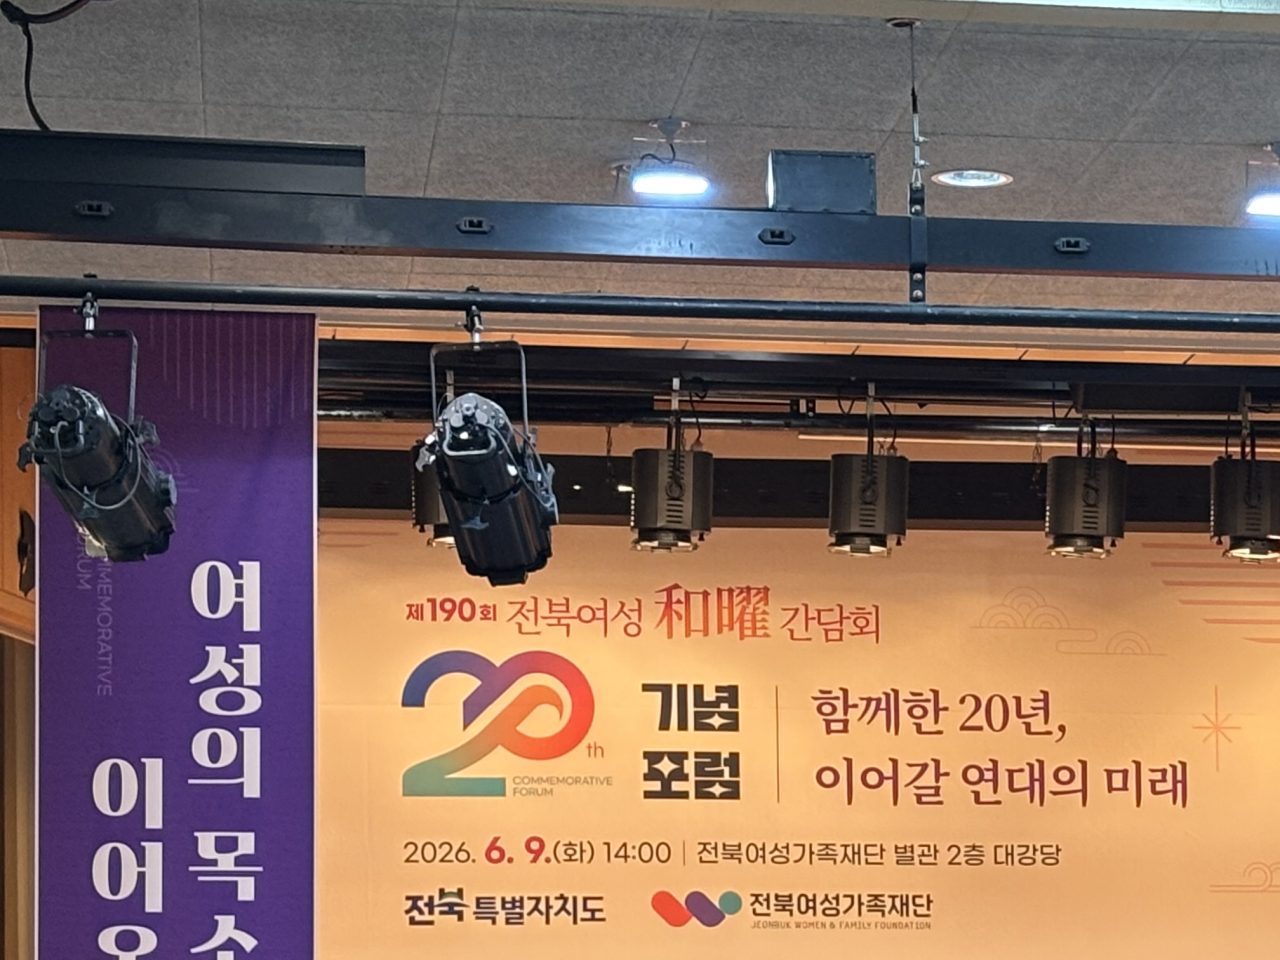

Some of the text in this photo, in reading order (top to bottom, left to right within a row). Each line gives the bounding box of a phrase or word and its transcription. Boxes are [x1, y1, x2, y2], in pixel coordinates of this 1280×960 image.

[97, 559, 112, 696] MEMORATIVE
[405, 583, 881, 644] 제190회 전북여성 和曜 간담회
[188, 560, 262, 798] 여성의
[641, 683, 740, 732] 기념
[811, 687, 1067, 743] 함께한 20년,
[512, 776, 613, 786] COMMEMORATIVE
[512, 787, 554, 797] FORUM
[642, 751, 741, 800] 포럼
[815, 756, 1188, 809] 이어갈 연대의 미래
[403, 841, 476, 864] 2026.
[484, 836, 514, 864] 6.
[603, 841, 672, 863] 14:00
[696, 841, 886, 866] 전북여성가족재단
[893, 842, 939, 866] 별관
[946, 844, 985, 866] 2층
[993, 843, 1062, 867] 대강당
[749, 892, 934, 918] 전북여성가족재단
[751, 920, 791, 929] JEONBUK
[795, 920, 827, 929] WOMEN
[839, 920, 871, 930] FAMILY
[875, 920, 931, 930] FOUNDATION
